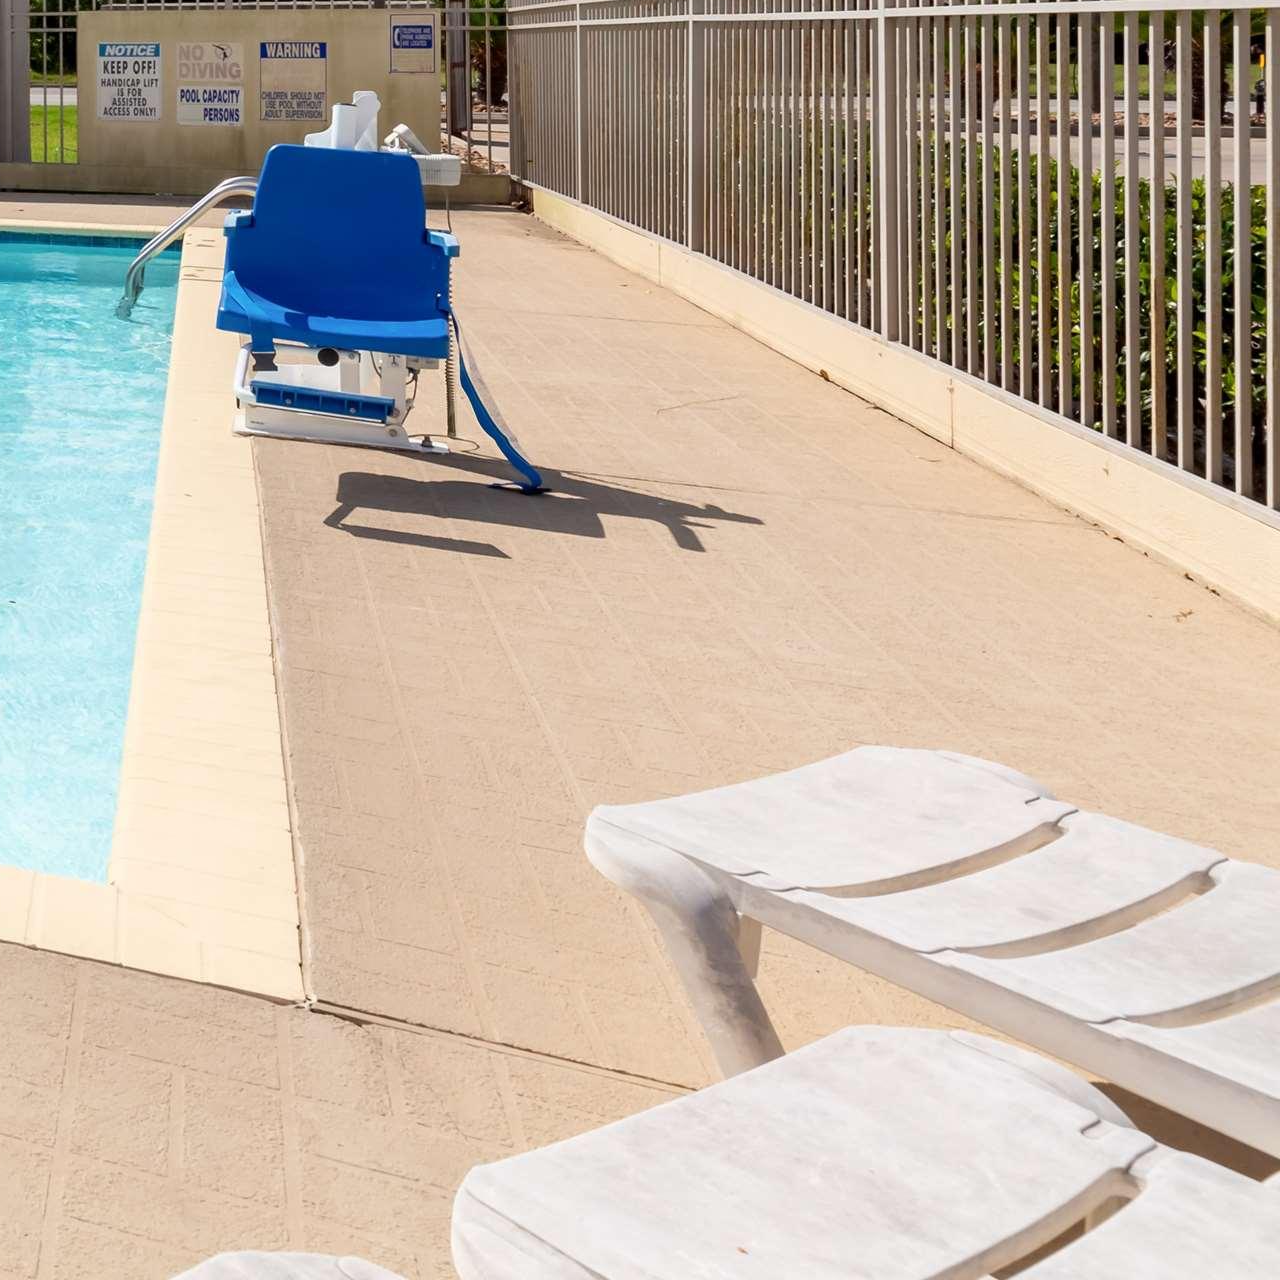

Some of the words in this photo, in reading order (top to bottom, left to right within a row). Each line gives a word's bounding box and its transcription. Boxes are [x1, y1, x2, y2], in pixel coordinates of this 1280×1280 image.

[105, 45, 156, 56] NOTICE
[179, 45, 204, 61] NO
[265, 43, 320, 58] WARNING
[103, 60, 128, 74] KEEP
[133, 60, 156, 74] OFF!
[179, 62, 241, 79] DIVING
[101, 79, 141, 87] HANDICAP
[143, 79, 159, 87] LIFT
[117, 88, 124, 97] IS
[127, 88, 142, 97] FOR
[180, 89, 201, 103] POOL
[202, 89, 240, 103] CAPACITY
[261, 91, 288, 100] CHILDREN
[290, 91, 312, 100] SHOULD
[314, 91, 325, 100] NOT
[112, 98, 147, 106] ASSISTED
[265, 100, 276, 109] USE
[279, 100, 295, 109] POOL
[296, 100, 322, 109] WITHOUT
[103, 107, 131, 116] ACCESS
[133, 107, 156, 116] ONLY!
[203, 108, 240, 122] PERSONS
[265, 109, 283, 118] ADULT
[285, 109, 323, 118] SUPERVISION
